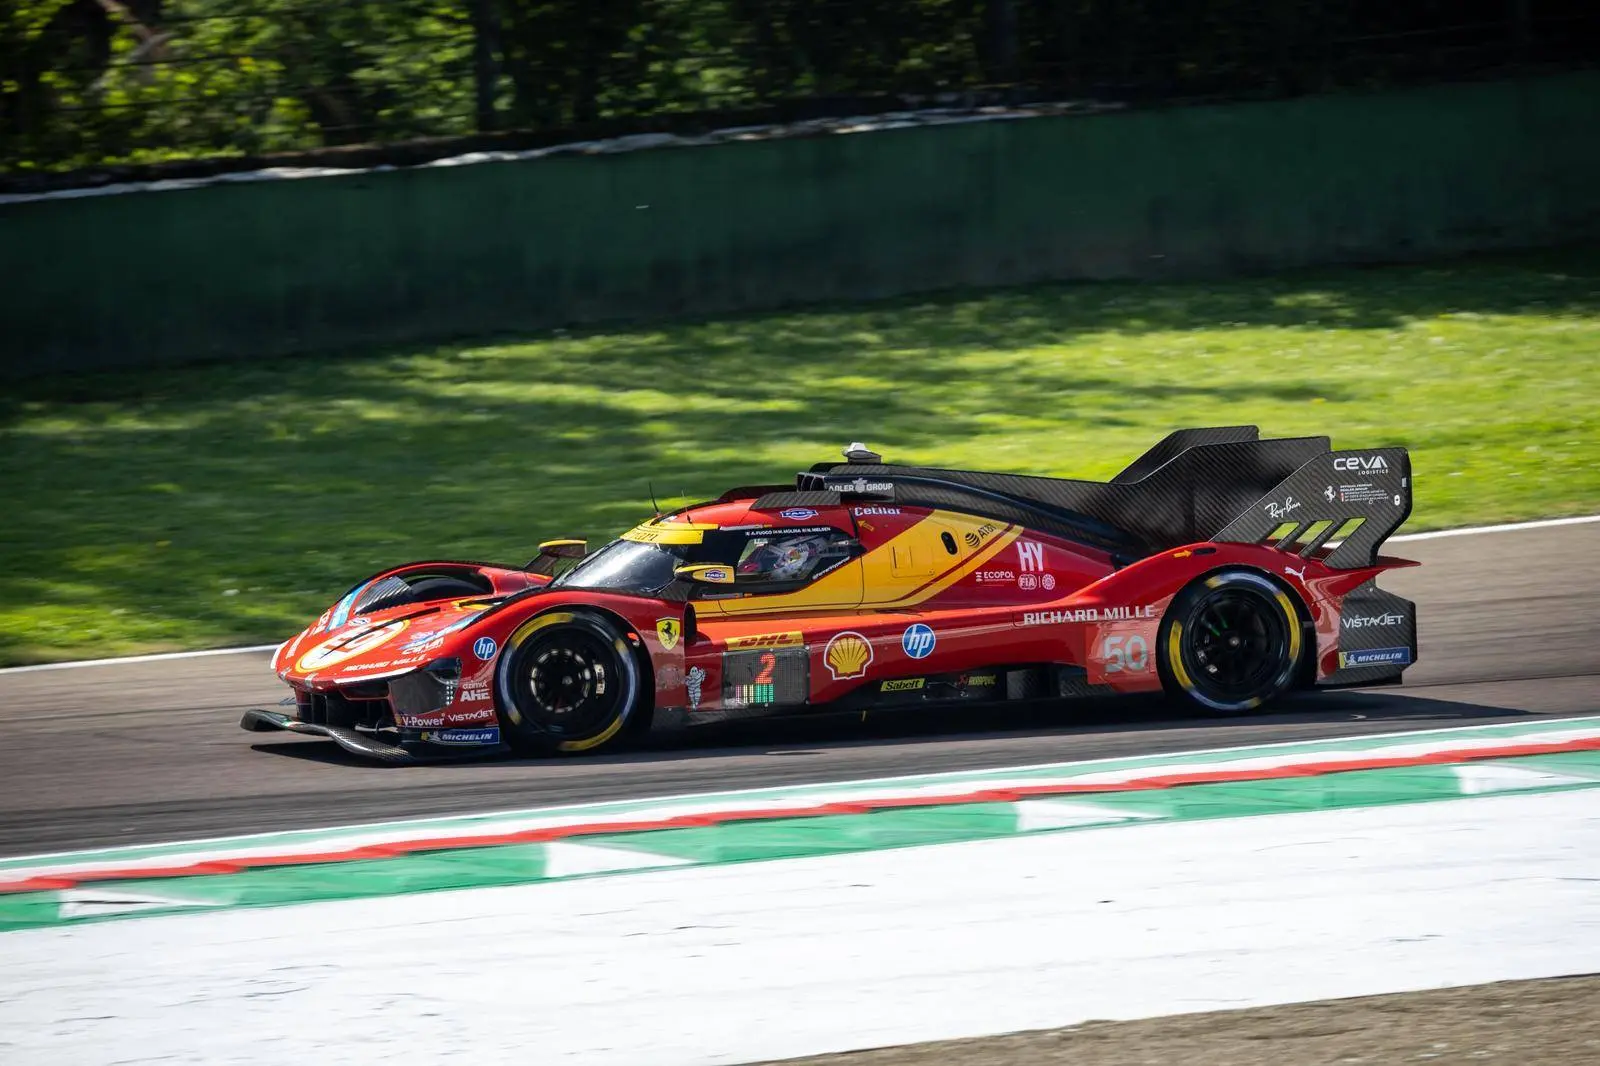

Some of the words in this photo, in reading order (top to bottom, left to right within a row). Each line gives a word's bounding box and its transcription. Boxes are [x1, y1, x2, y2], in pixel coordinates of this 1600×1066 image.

[866, 483, 893, 491] GROUP
[1016, 541, 1044, 572] HY
[983, 571, 1015, 579] ECOPOL
[1020, 577, 1035, 588] FIA
[1023, 608, 1098, 625] RICHARD
[1104, 604, 1156, 619] MILLE
[1342, 611, 1404, 628] VISTAJET
[738, 633, 793, 647] DHL
[908, 624, 932, 658] hp
[477, 639, 494, 659] hp
[1104, 635, 1147, 672] 50
[1357, 653, 1403, 662] MICHELIN
[755, 653, 776, 684] 2
[402, 716, 444, 726] V-Power
[448, 709, 495, 722] VISTAJET
[441, 732, 493, 740] MICHELIN
